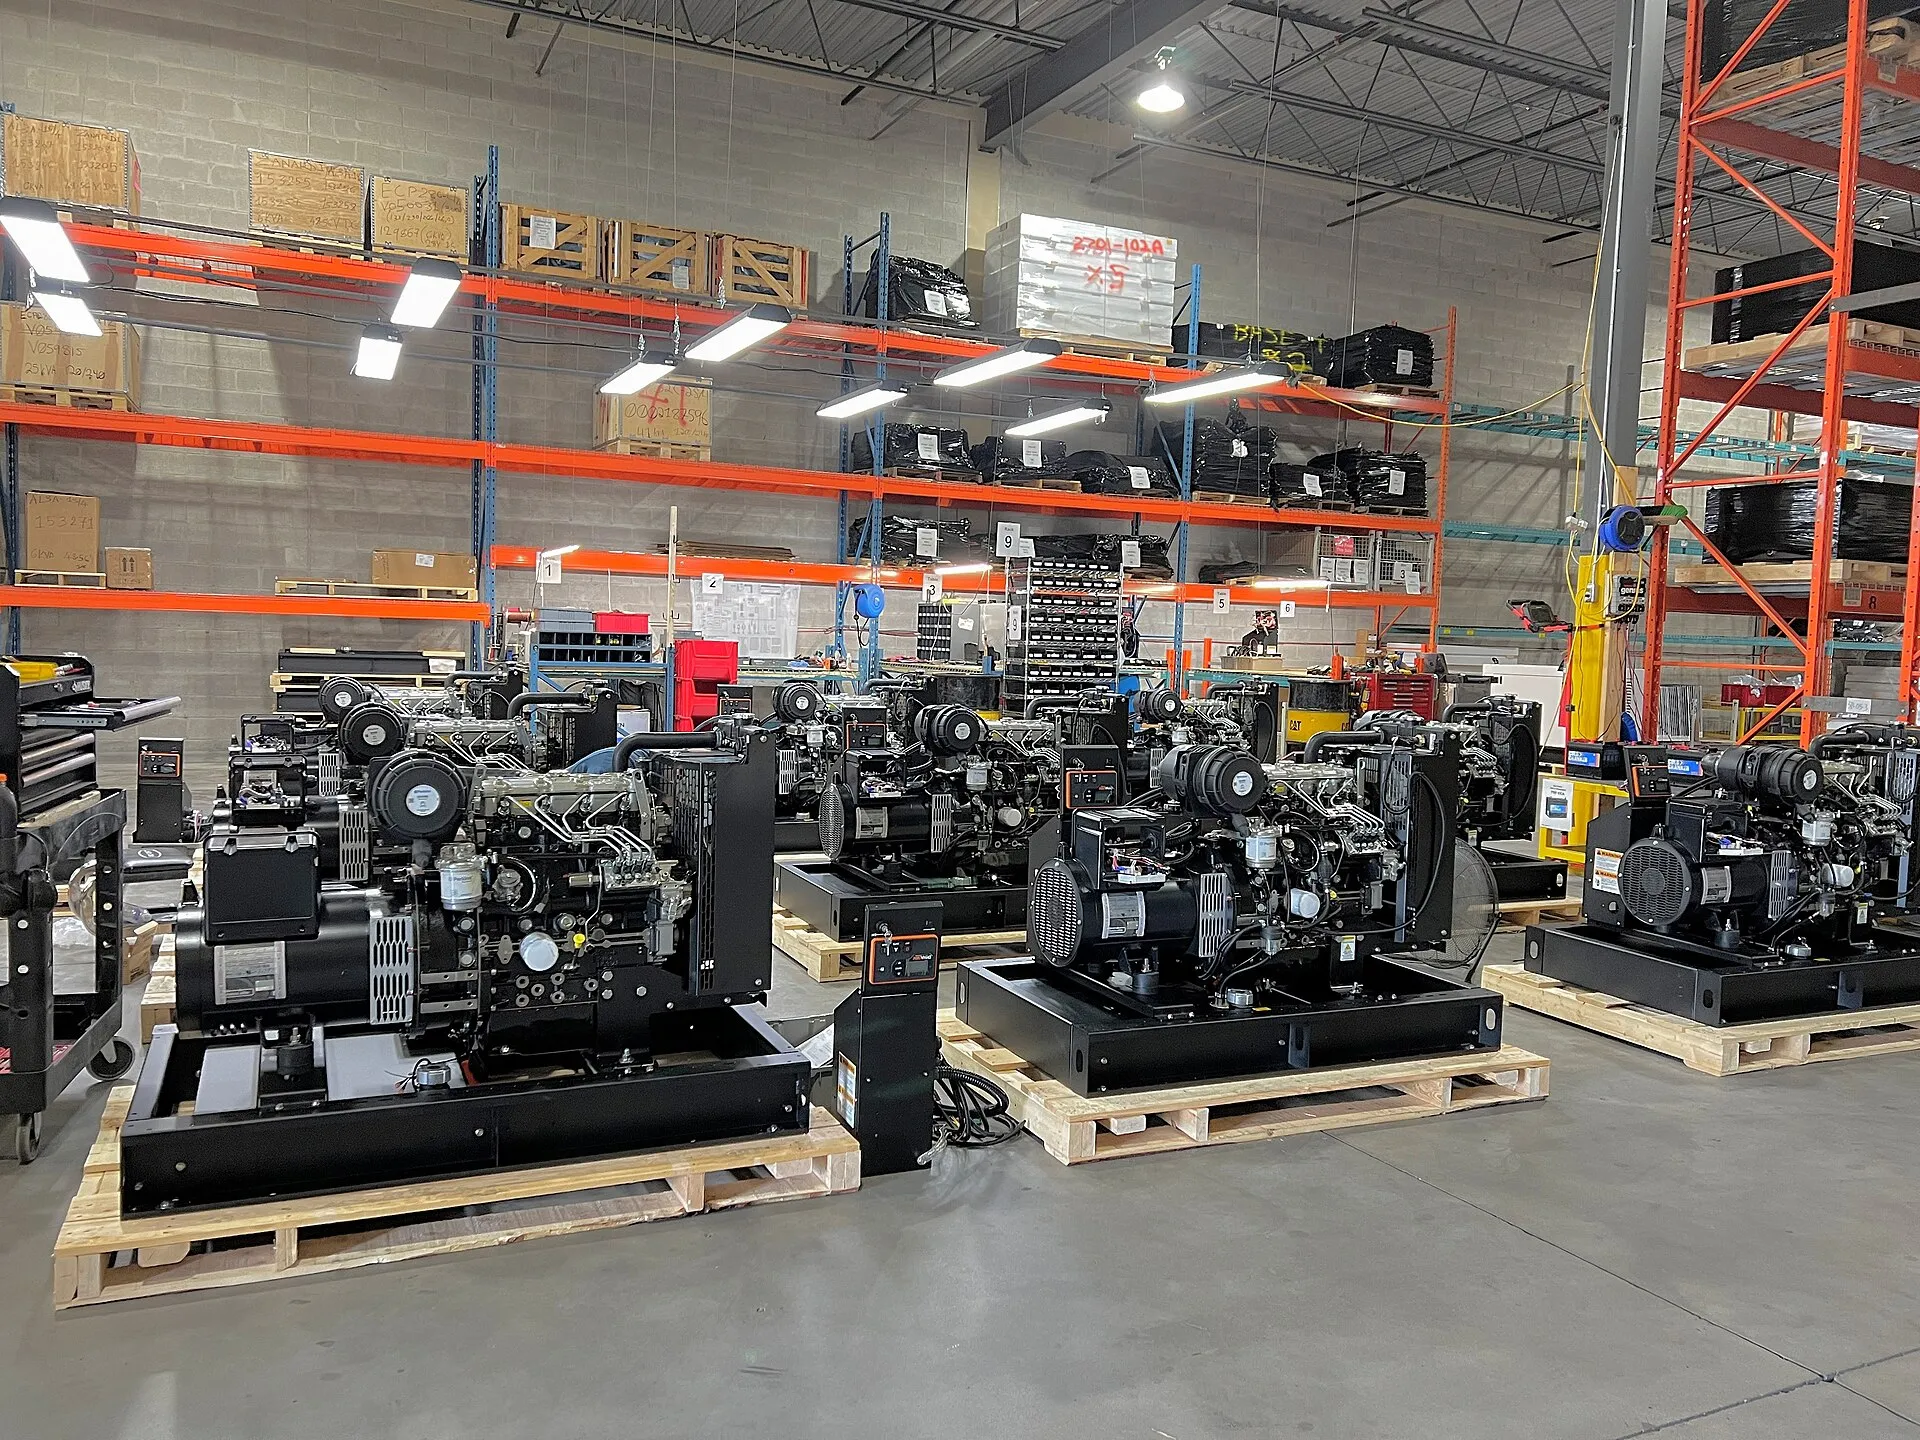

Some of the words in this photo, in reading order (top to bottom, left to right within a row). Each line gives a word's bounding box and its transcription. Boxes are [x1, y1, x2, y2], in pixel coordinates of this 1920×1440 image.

[1004, 535, 1013, 549] 9
[545, 564, 551, 576] 1
[1400, 569, 1406, 579] 3
[708, 576, 717, 588] 2
[928, 584, 936, 596] 3
[1218, 598, 1225, 609] 5
[1285, 603, 1291, 613] 6
[1012, 618, 1018, 632] 9
[1290, 719, 1302, 731] CAT
